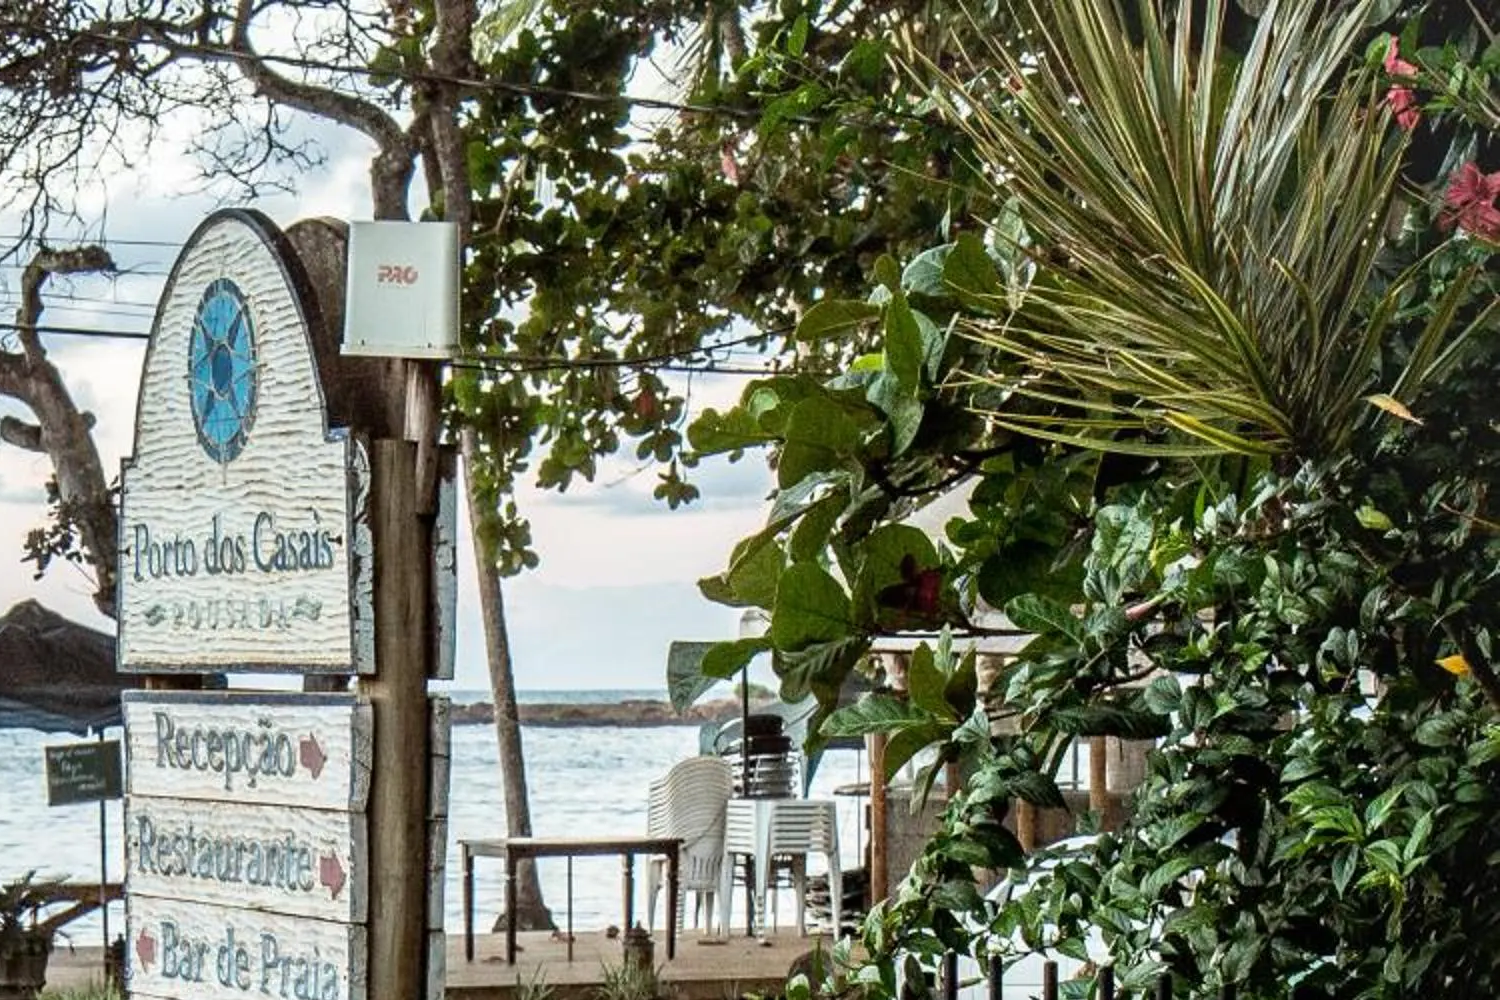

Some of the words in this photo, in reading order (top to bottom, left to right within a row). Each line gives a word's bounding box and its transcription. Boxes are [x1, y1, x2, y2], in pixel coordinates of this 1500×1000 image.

[133, 523, 198, 582] Porto
[204, 511, 247, 575] dos
[253, 508, 334, 573] Casais
[153, 711, 296, 791] Recepção
[136, 815, 315, 892] Restaurante
[160, 920, 210, 983] Bar
[217, 922, 251, 991] de
